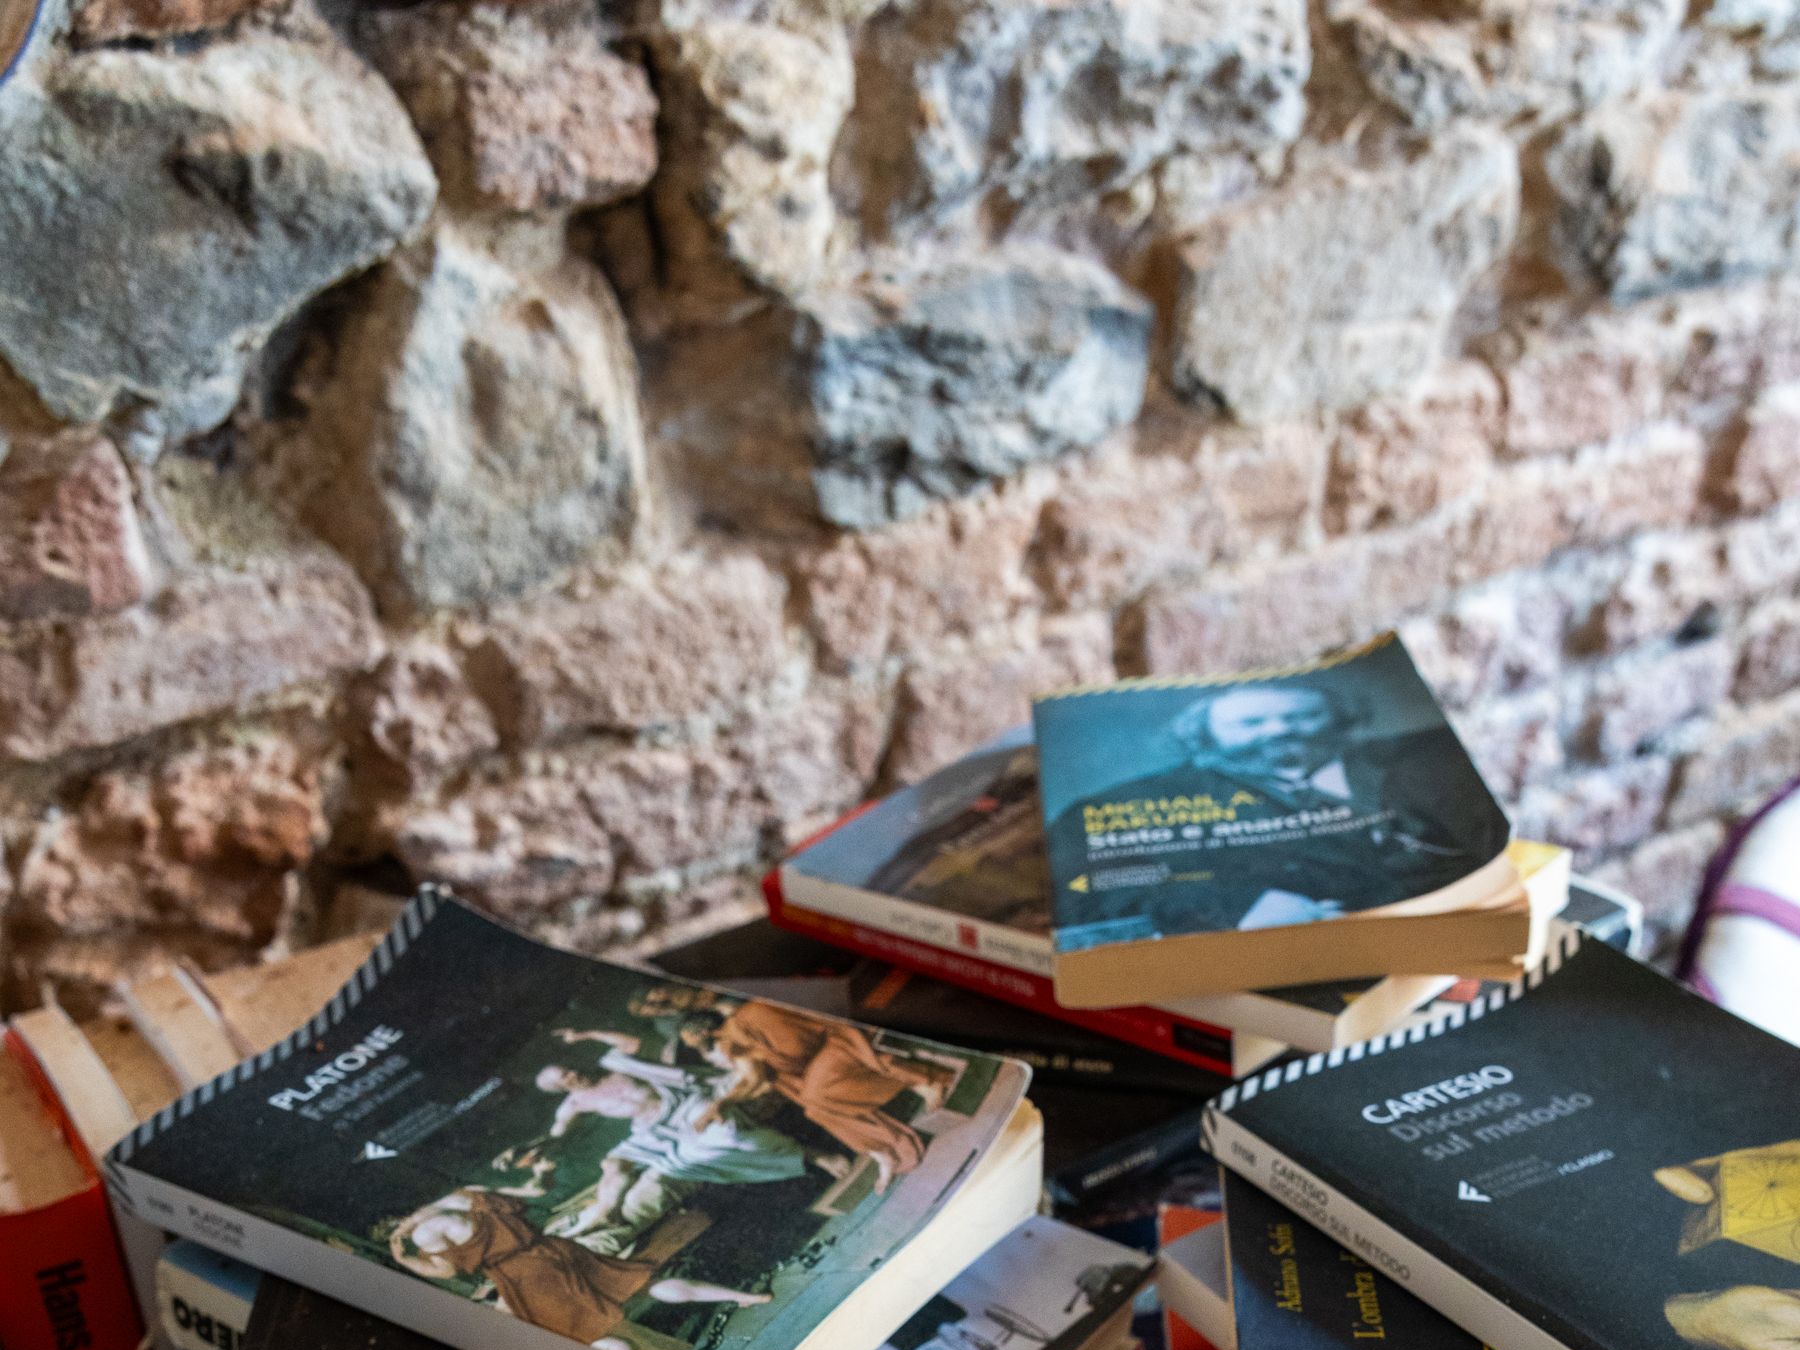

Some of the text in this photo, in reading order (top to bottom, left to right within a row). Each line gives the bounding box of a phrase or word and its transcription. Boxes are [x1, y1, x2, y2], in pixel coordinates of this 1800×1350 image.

[1086, 828, 1174, 849] Stato
[1212, 805, 1352, 837] anarchia
[268, 1023, 403, 1111] PLATONE
[1361, 1064, 1514, 1124] CARTESIO
[1389, 1091, 1522, 1143] Discorso
[1421, 1091, 1594, 1162] sul metodo
